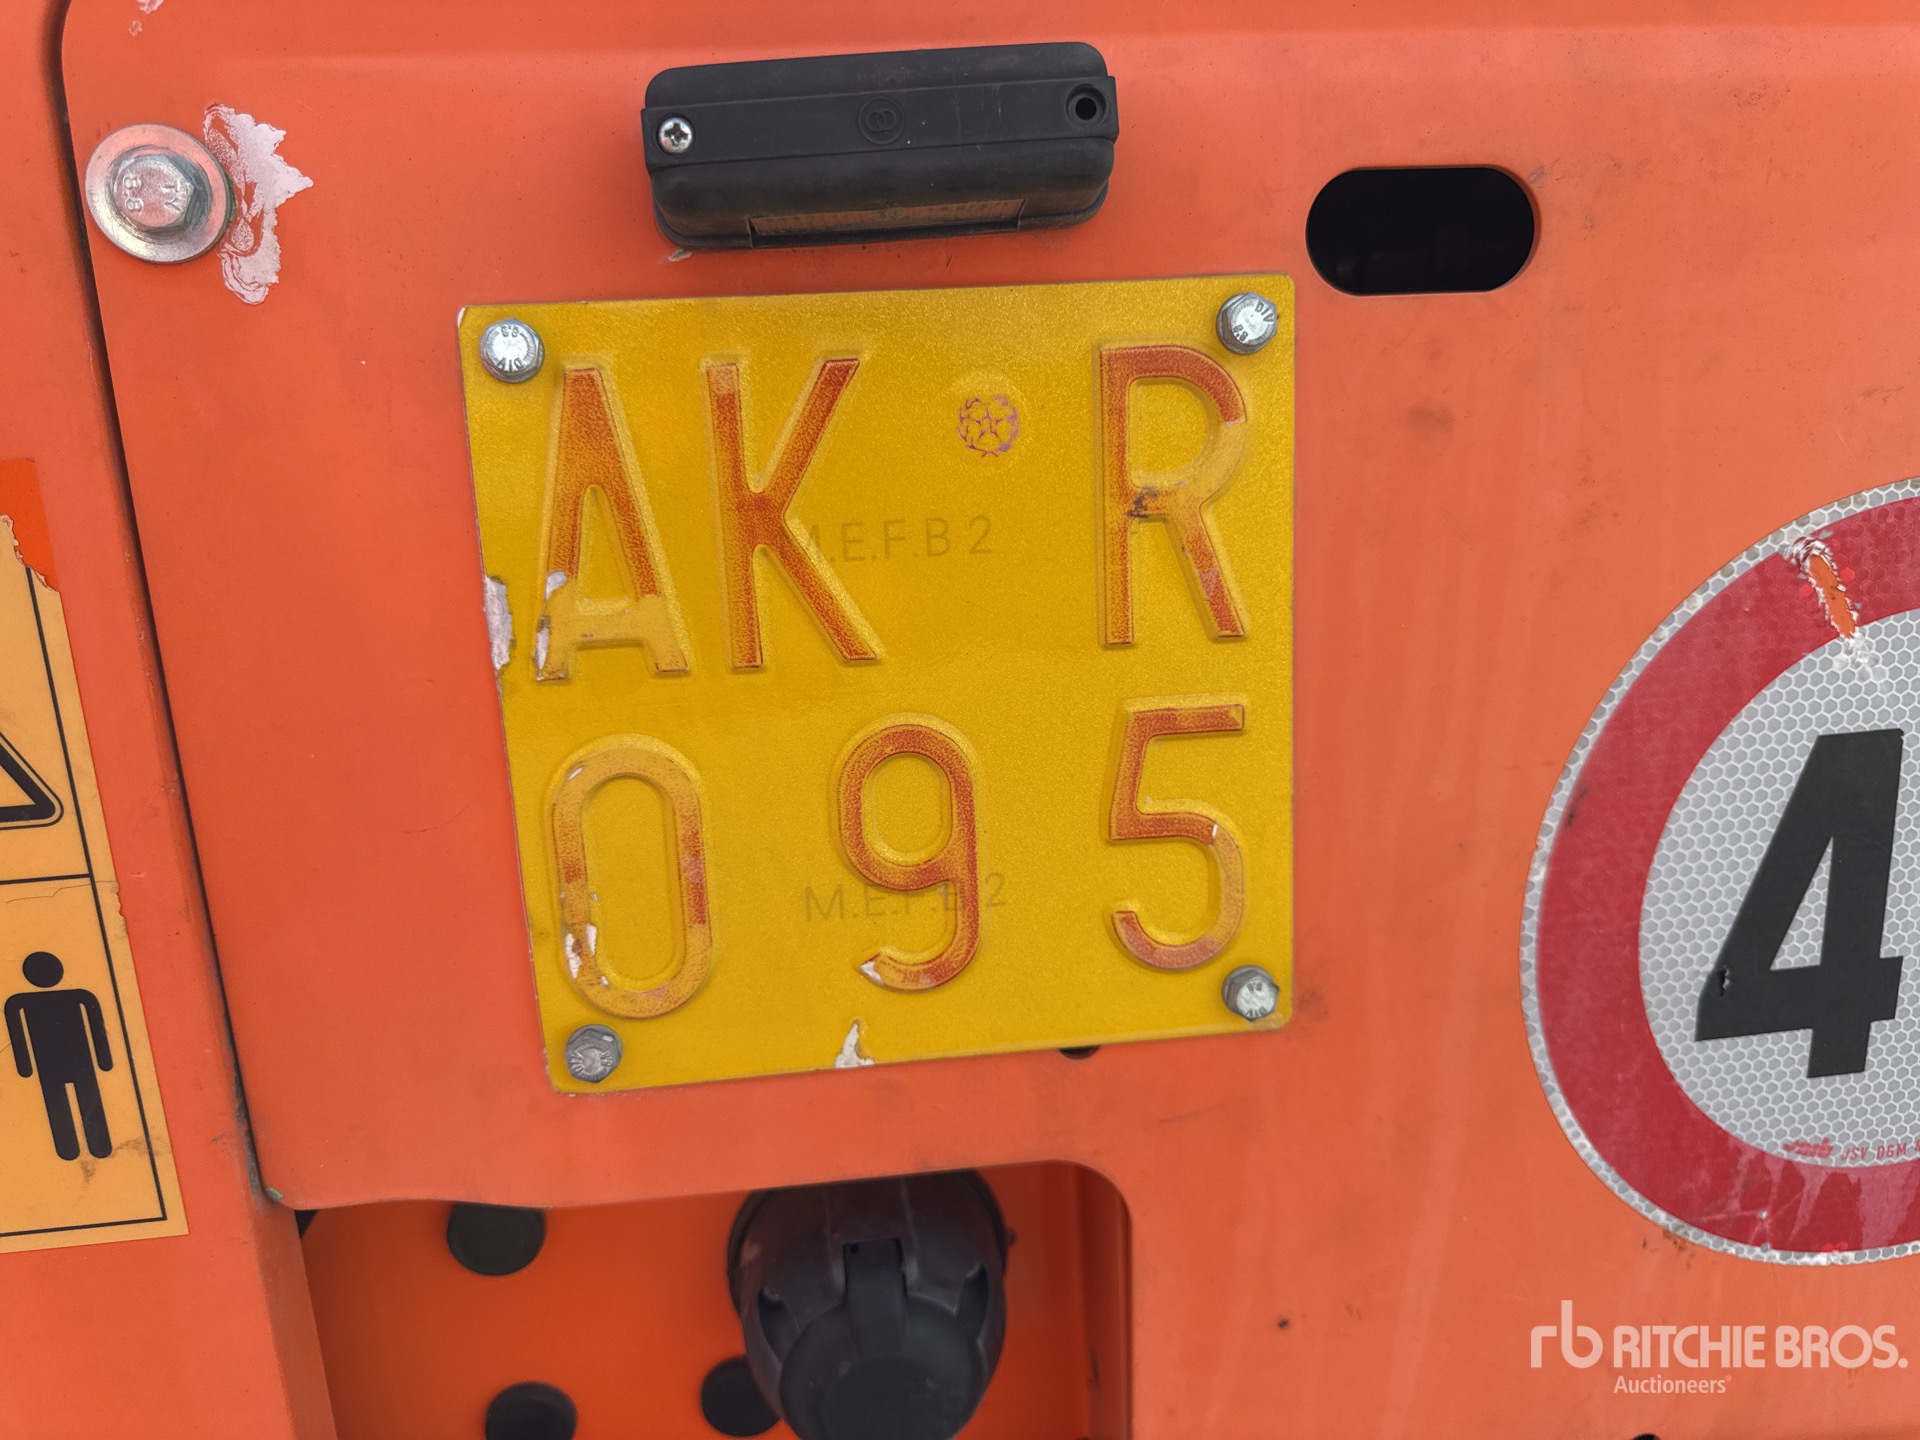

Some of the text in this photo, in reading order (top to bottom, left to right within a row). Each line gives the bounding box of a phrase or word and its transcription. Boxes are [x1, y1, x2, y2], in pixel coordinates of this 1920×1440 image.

[534, 344, 1248, 682] AK R
[967, 514, 993, 555] 2
[551, 703, 1247, 1018] 095
[1695, 728, 1904, 1079] 4
